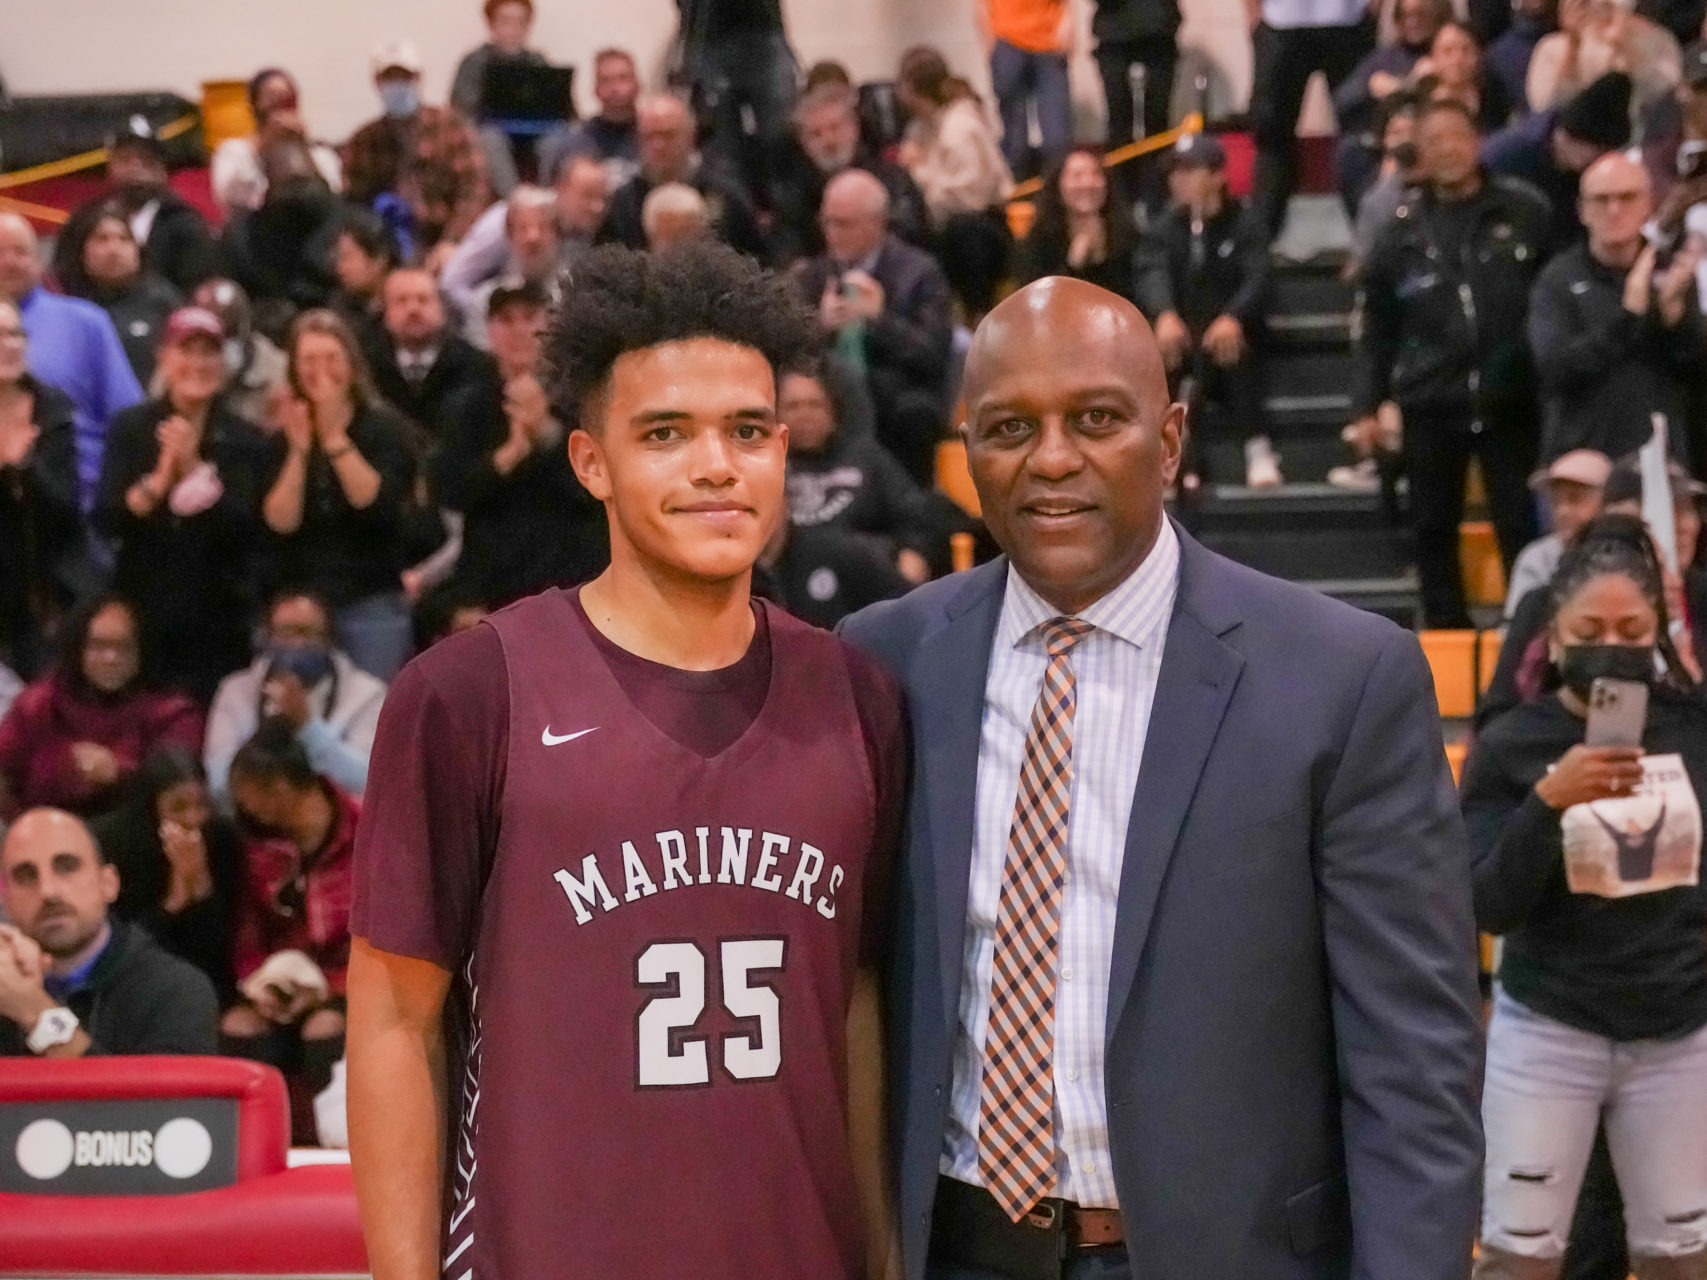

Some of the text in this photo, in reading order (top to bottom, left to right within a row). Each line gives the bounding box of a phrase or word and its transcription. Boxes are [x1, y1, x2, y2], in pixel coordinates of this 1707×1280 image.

[552, 825, 846, 927] MARINERS
[635, 937, 787, 1088] 25
[74, 1130, 154, 1167] BONUS
